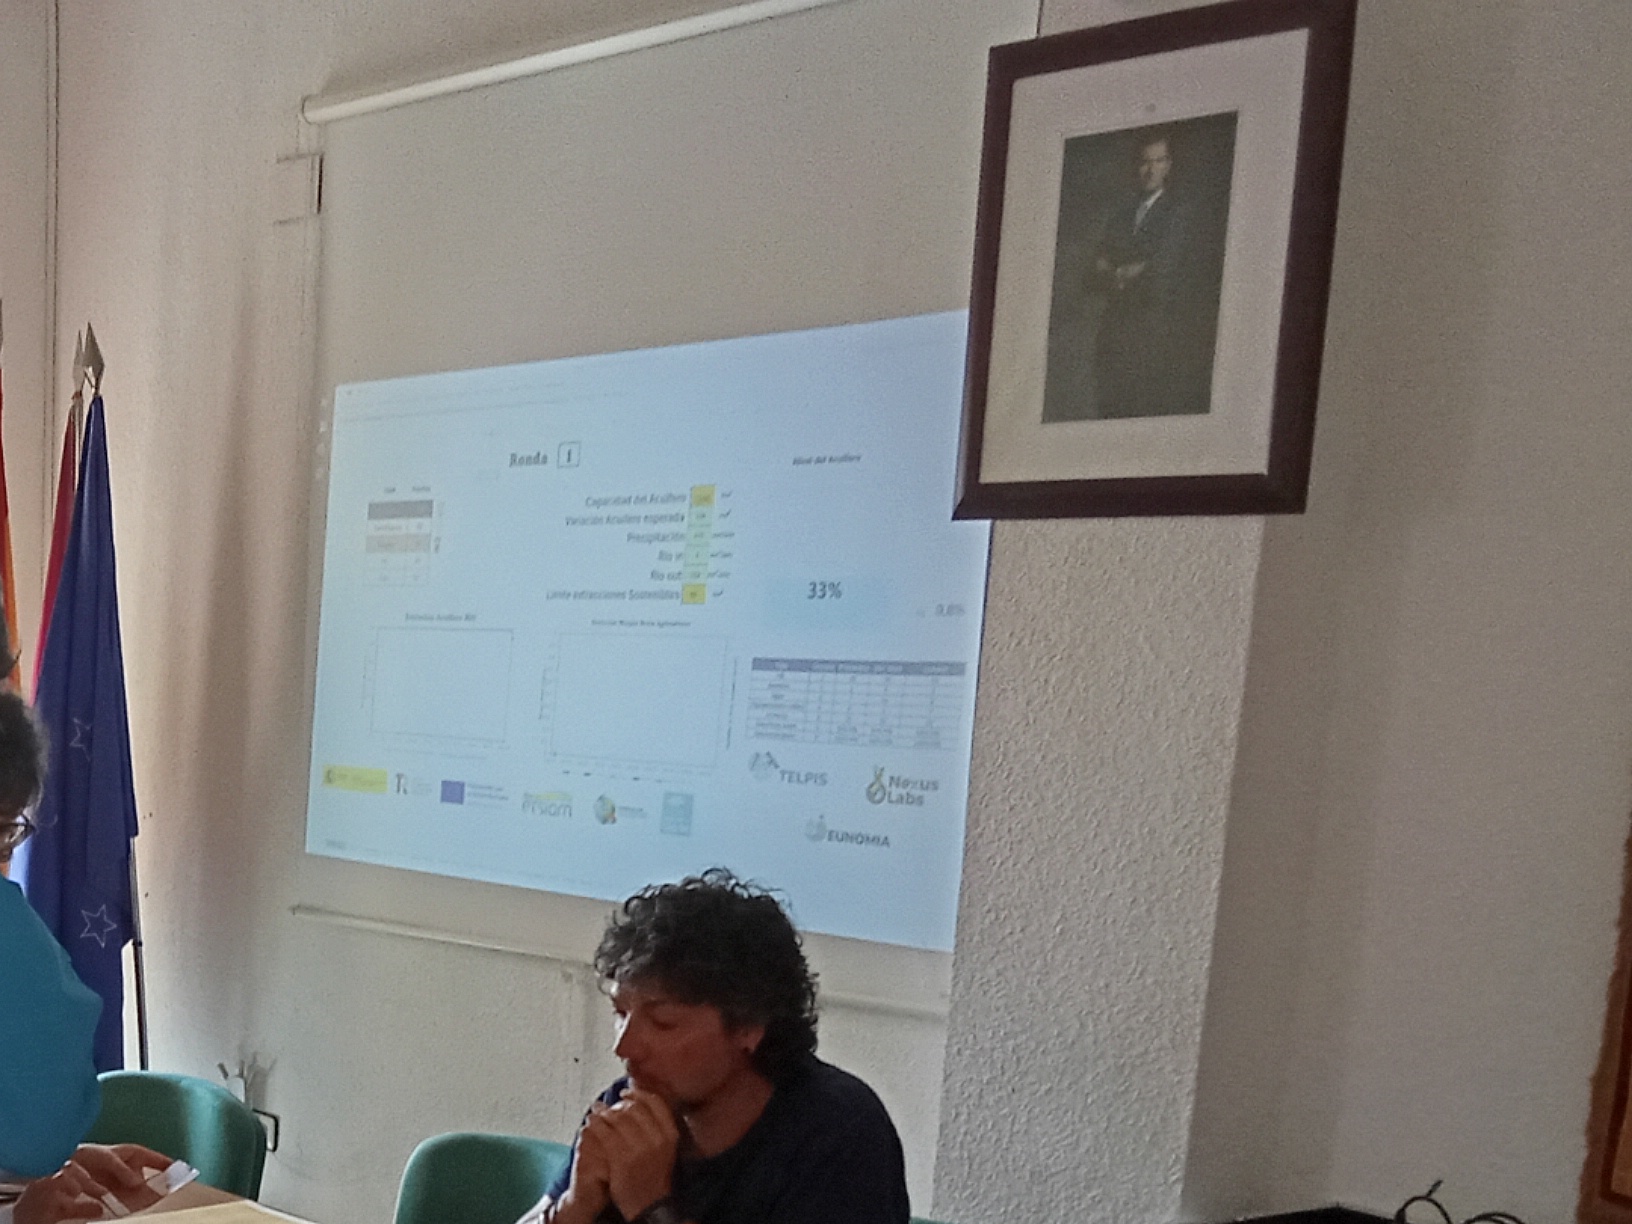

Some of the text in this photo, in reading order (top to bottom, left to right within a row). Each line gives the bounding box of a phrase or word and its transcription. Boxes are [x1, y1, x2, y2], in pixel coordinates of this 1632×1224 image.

[509, 451, 548, 468] Ronda
[807, 581, 842, 599] 33%
[779, 769, 828, 786] TELPIS
[888, 775, 939, 791] Nexus
[887, 790, 925, 806] Labs
[827, 829, 890, 848] EUNOMIA
